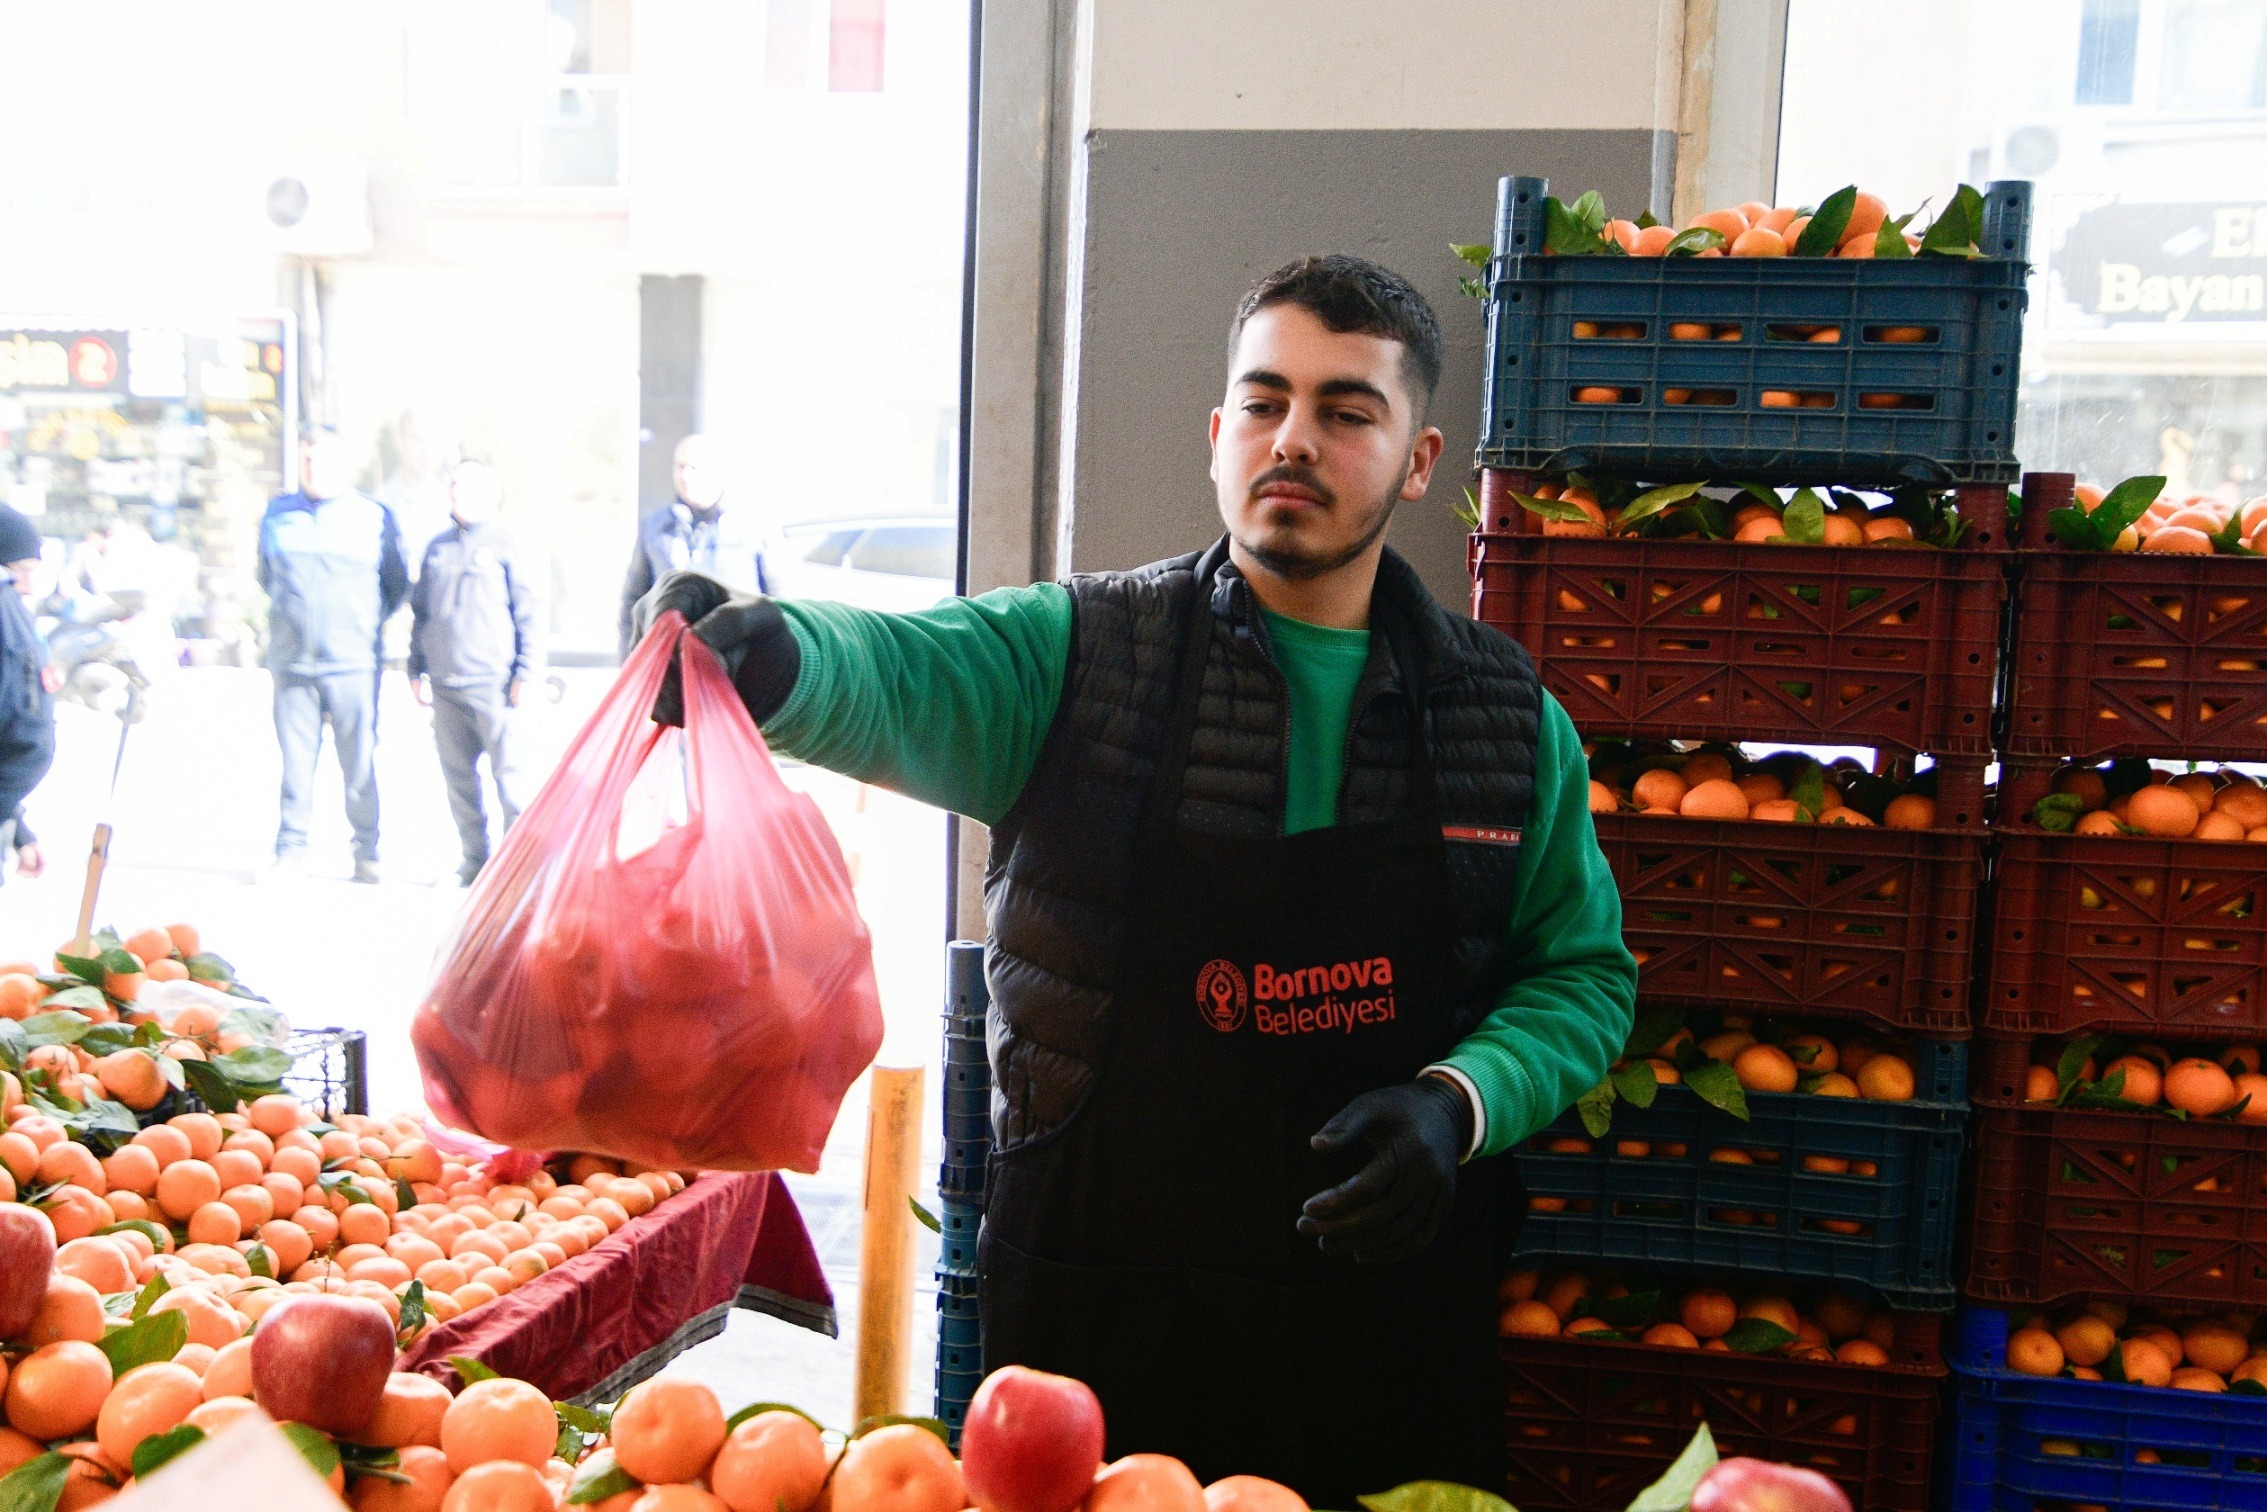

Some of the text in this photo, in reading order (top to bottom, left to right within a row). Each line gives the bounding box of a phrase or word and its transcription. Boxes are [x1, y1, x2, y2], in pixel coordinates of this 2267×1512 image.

[2097, 263, 2265, 322] Bayan
[1253, 957, 1394, 1000] Bornova
[1254, 989, 1396, 1036] Belediyesi
